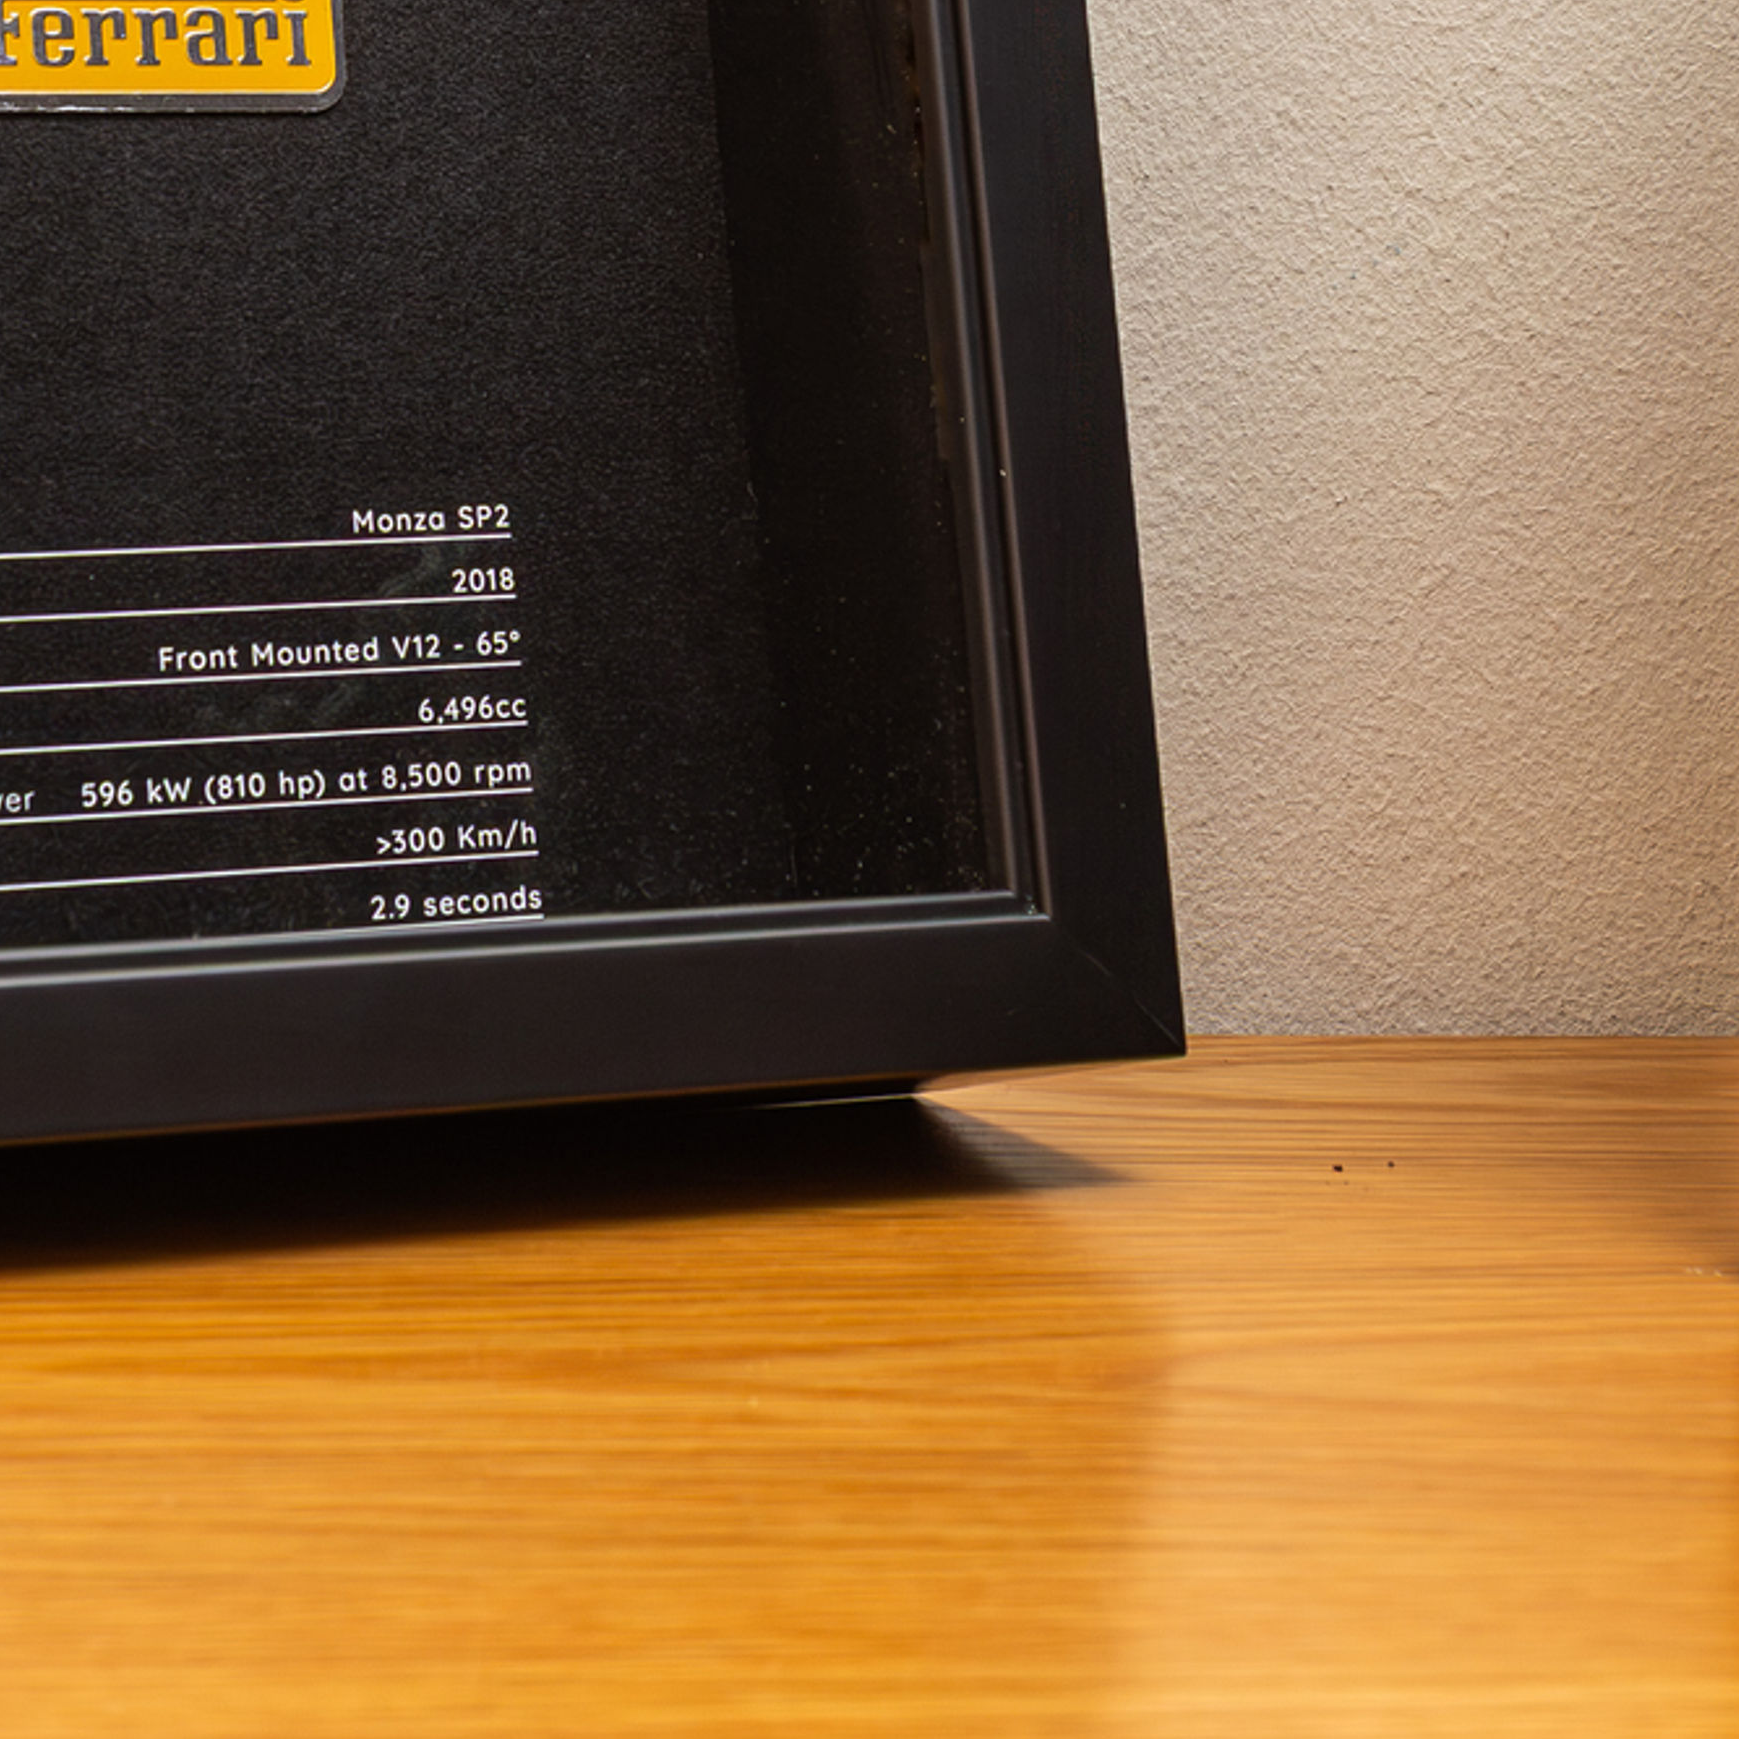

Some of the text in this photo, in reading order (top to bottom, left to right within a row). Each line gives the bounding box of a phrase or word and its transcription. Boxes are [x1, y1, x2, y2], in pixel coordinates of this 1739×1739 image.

[352, 503, 510, 534] Monza SP2
[451, 566, 516, 594] 2018
[158, 645, 239, 672] Front
[251, 636, 380, 667] Mounted
[391, 633, 441, 660] V12
[476, 629, 521, 656] 65°
[418, 694, 527, 725] 6,496cc
[81, 760, 532, 808] 596 kW (810 hp) at 8,500 rpm
[376, 819, 537, 855] >300 Km/h
[370, 884, 543, 921] 2.9 seconds
